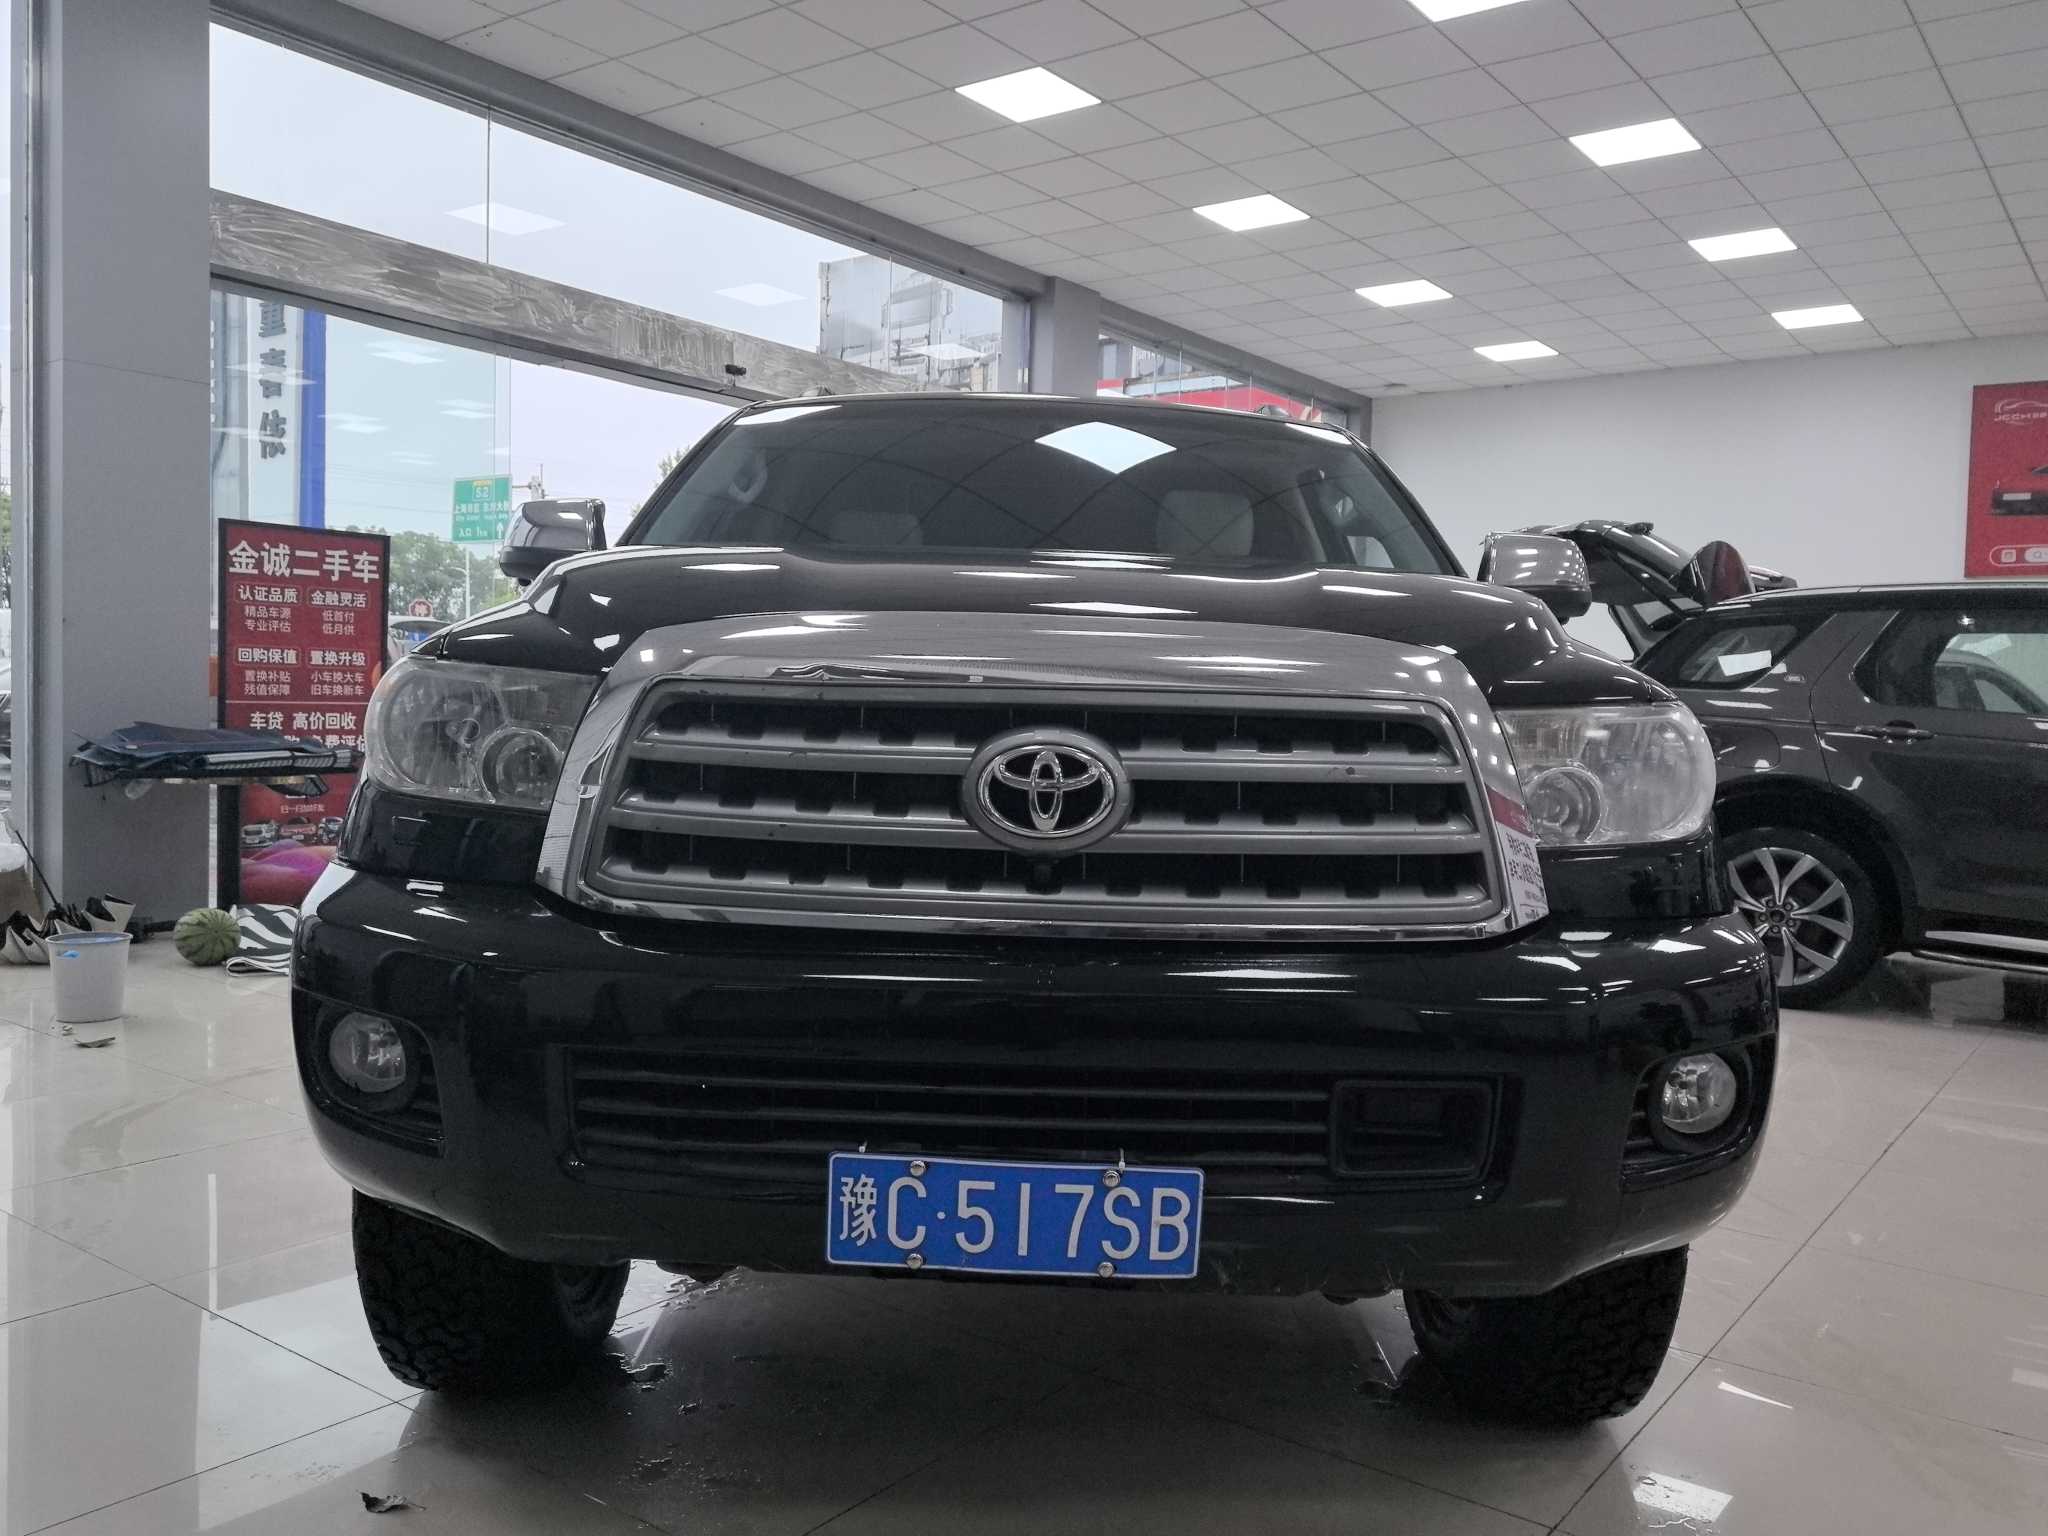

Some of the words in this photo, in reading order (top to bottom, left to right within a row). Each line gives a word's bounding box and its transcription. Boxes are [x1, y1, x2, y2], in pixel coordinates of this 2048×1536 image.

[228, 541, 380, 583] 金诚二手车
[238, 585, 299, 604] 认证品质
[311, 591, 367, 608] 金融灵活
[244, 606, 291, 620] 精品车源
[322, 610, 355, 623] 低首付
[244, 619, 292, 633] 专业评估
[322, 624, 355, 636] 低月供
[238, 648, 297, 664] 回购保值
[309, 650, 366, 667] 置换升级
[244, 670, 291, 683] 置换补贴
[311, 671, 365, 684] 小车换大车
[244, 683, 291, 696] 残值保障
[311, 684, 365, 696] 旧车换新车
[250, 711, 284, 730] 车贷
[292, 711, 357, 731] 高价回收
[839, 1174, 1192, 1262] 豫C·517SB
